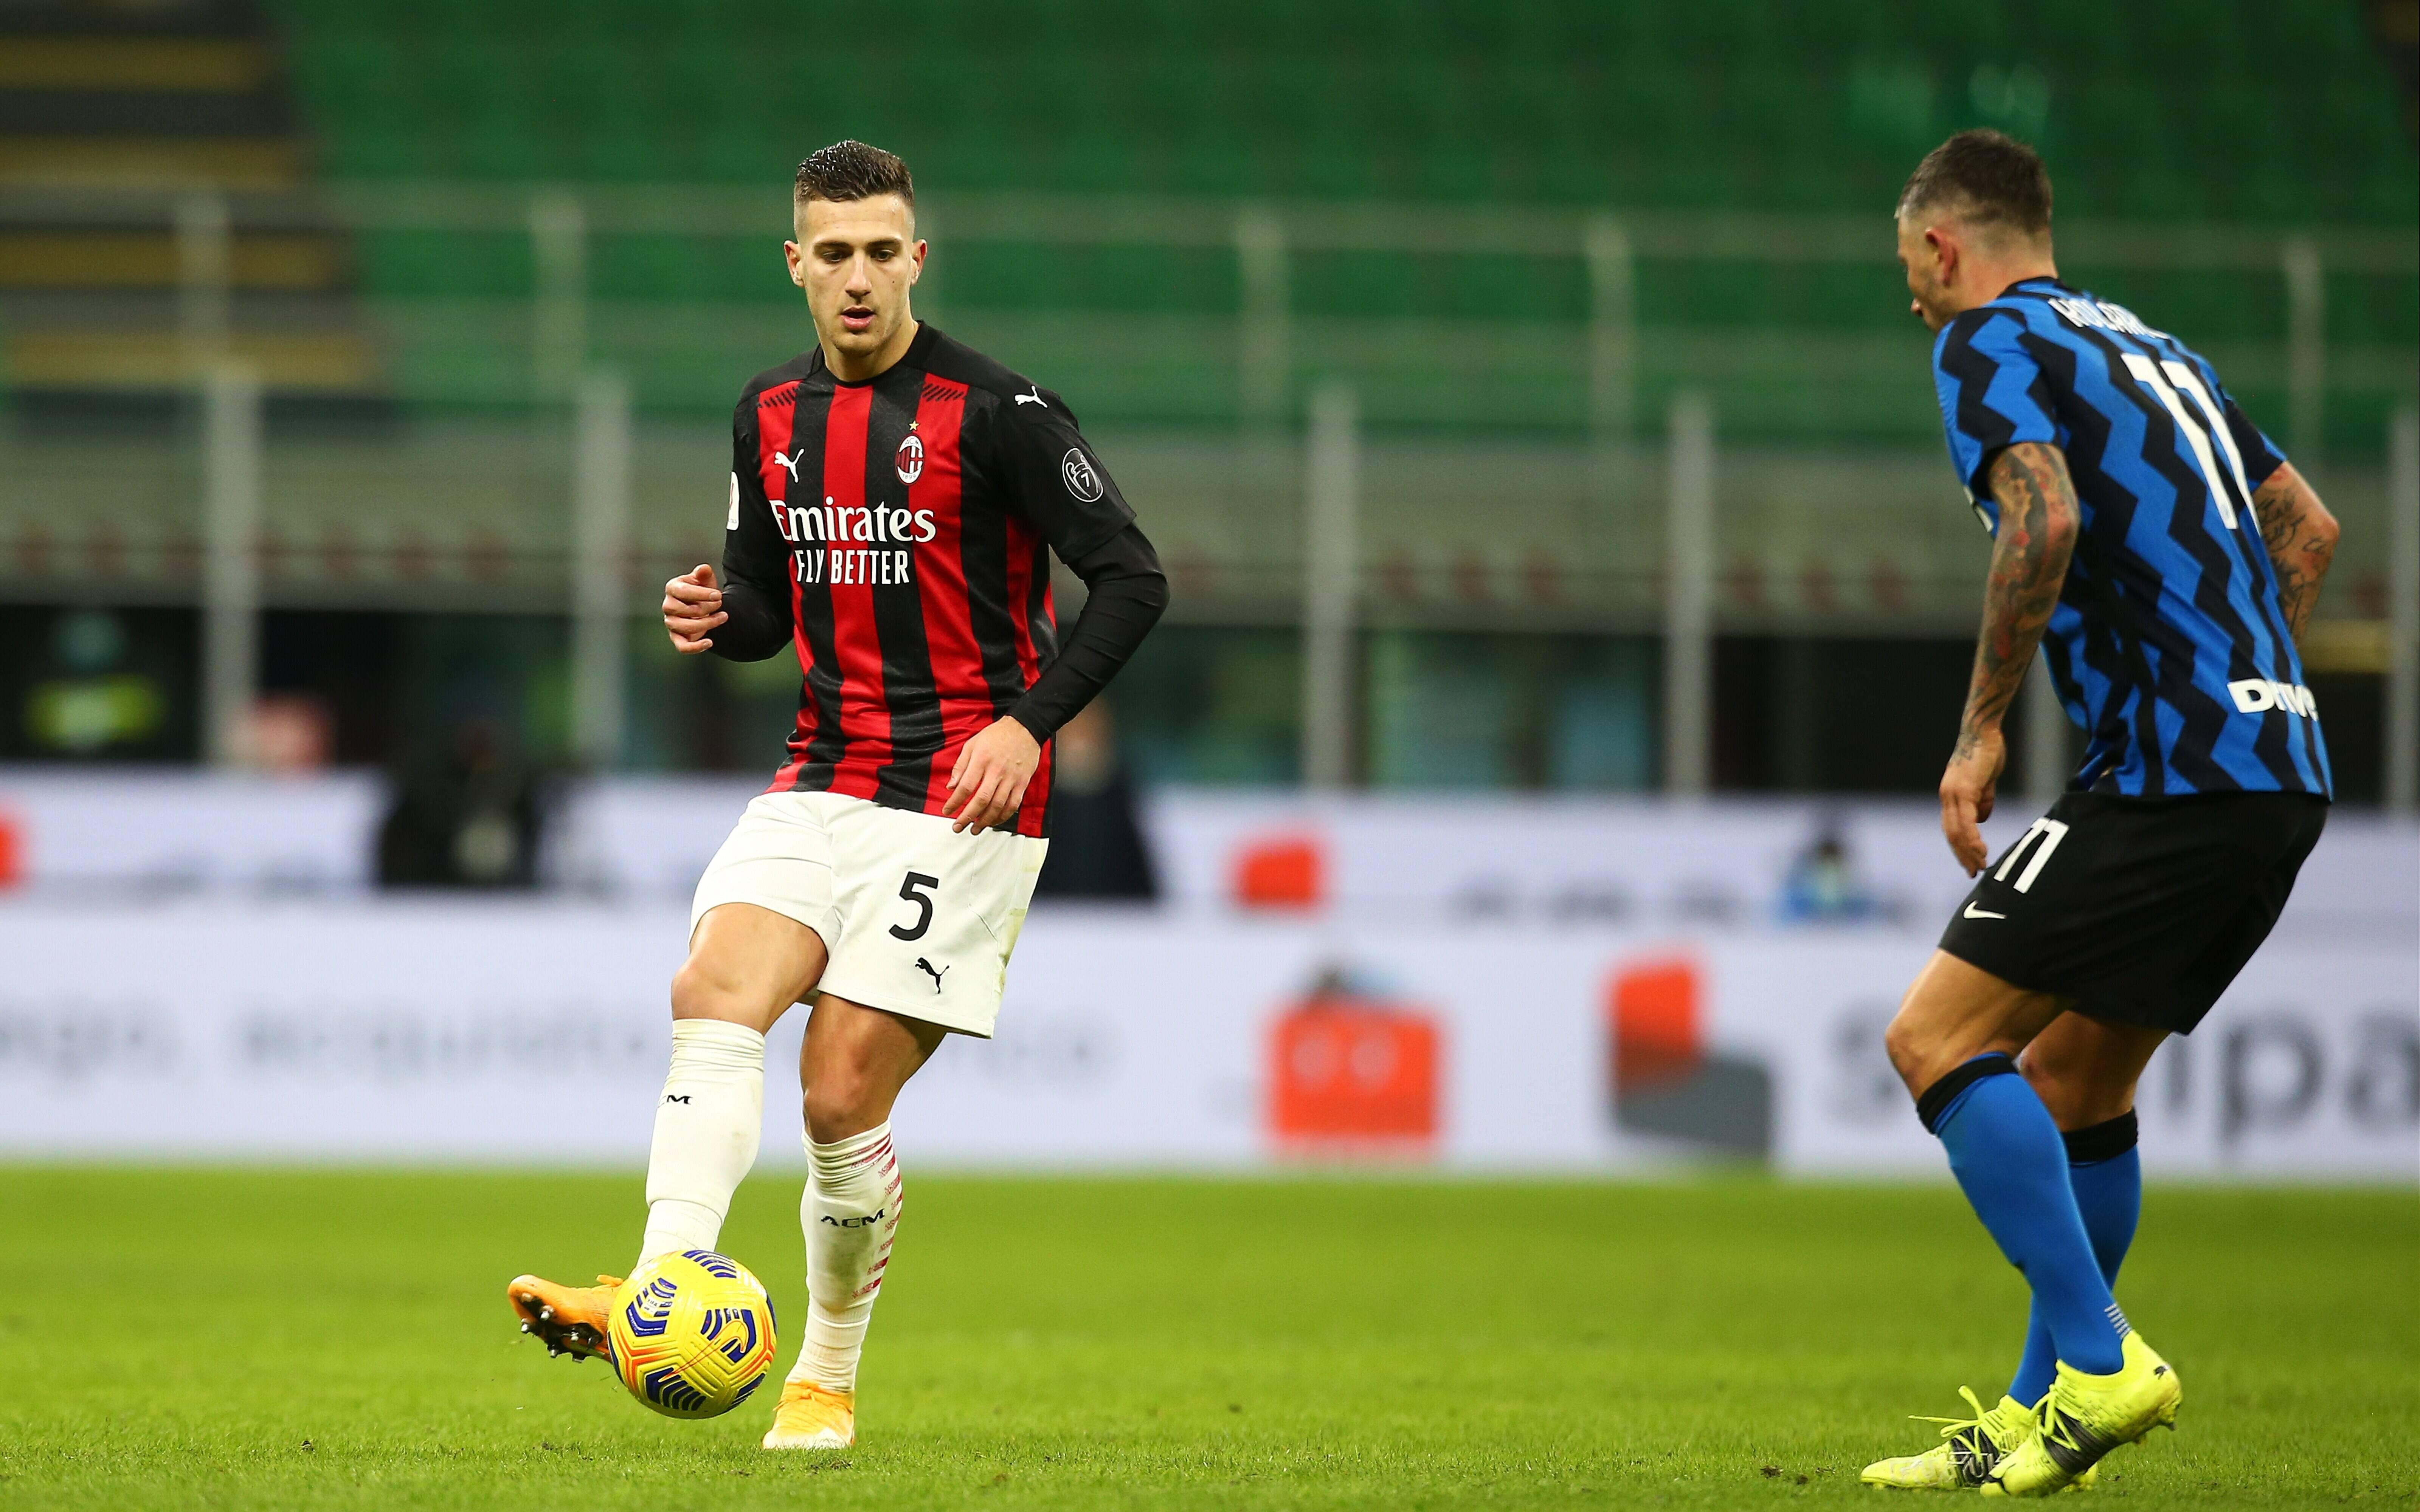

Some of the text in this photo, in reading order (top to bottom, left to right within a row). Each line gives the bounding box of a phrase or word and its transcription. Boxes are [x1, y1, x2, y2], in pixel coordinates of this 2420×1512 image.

[2048, 297, 2171, 339] KOLAR
[904, 438, 920, 447] ACM
[2120, 353, 2261, 538] 11
[1080, 472, 1090, 488] 7
[769, 496, 937, 542] Emirates
[795, 549, 910, 584] FLY BETTER
[1993, 816, 2070, 894] 11
[888, 871, 939, 941] 5
[821, 1208, 885, 1228] ACM
